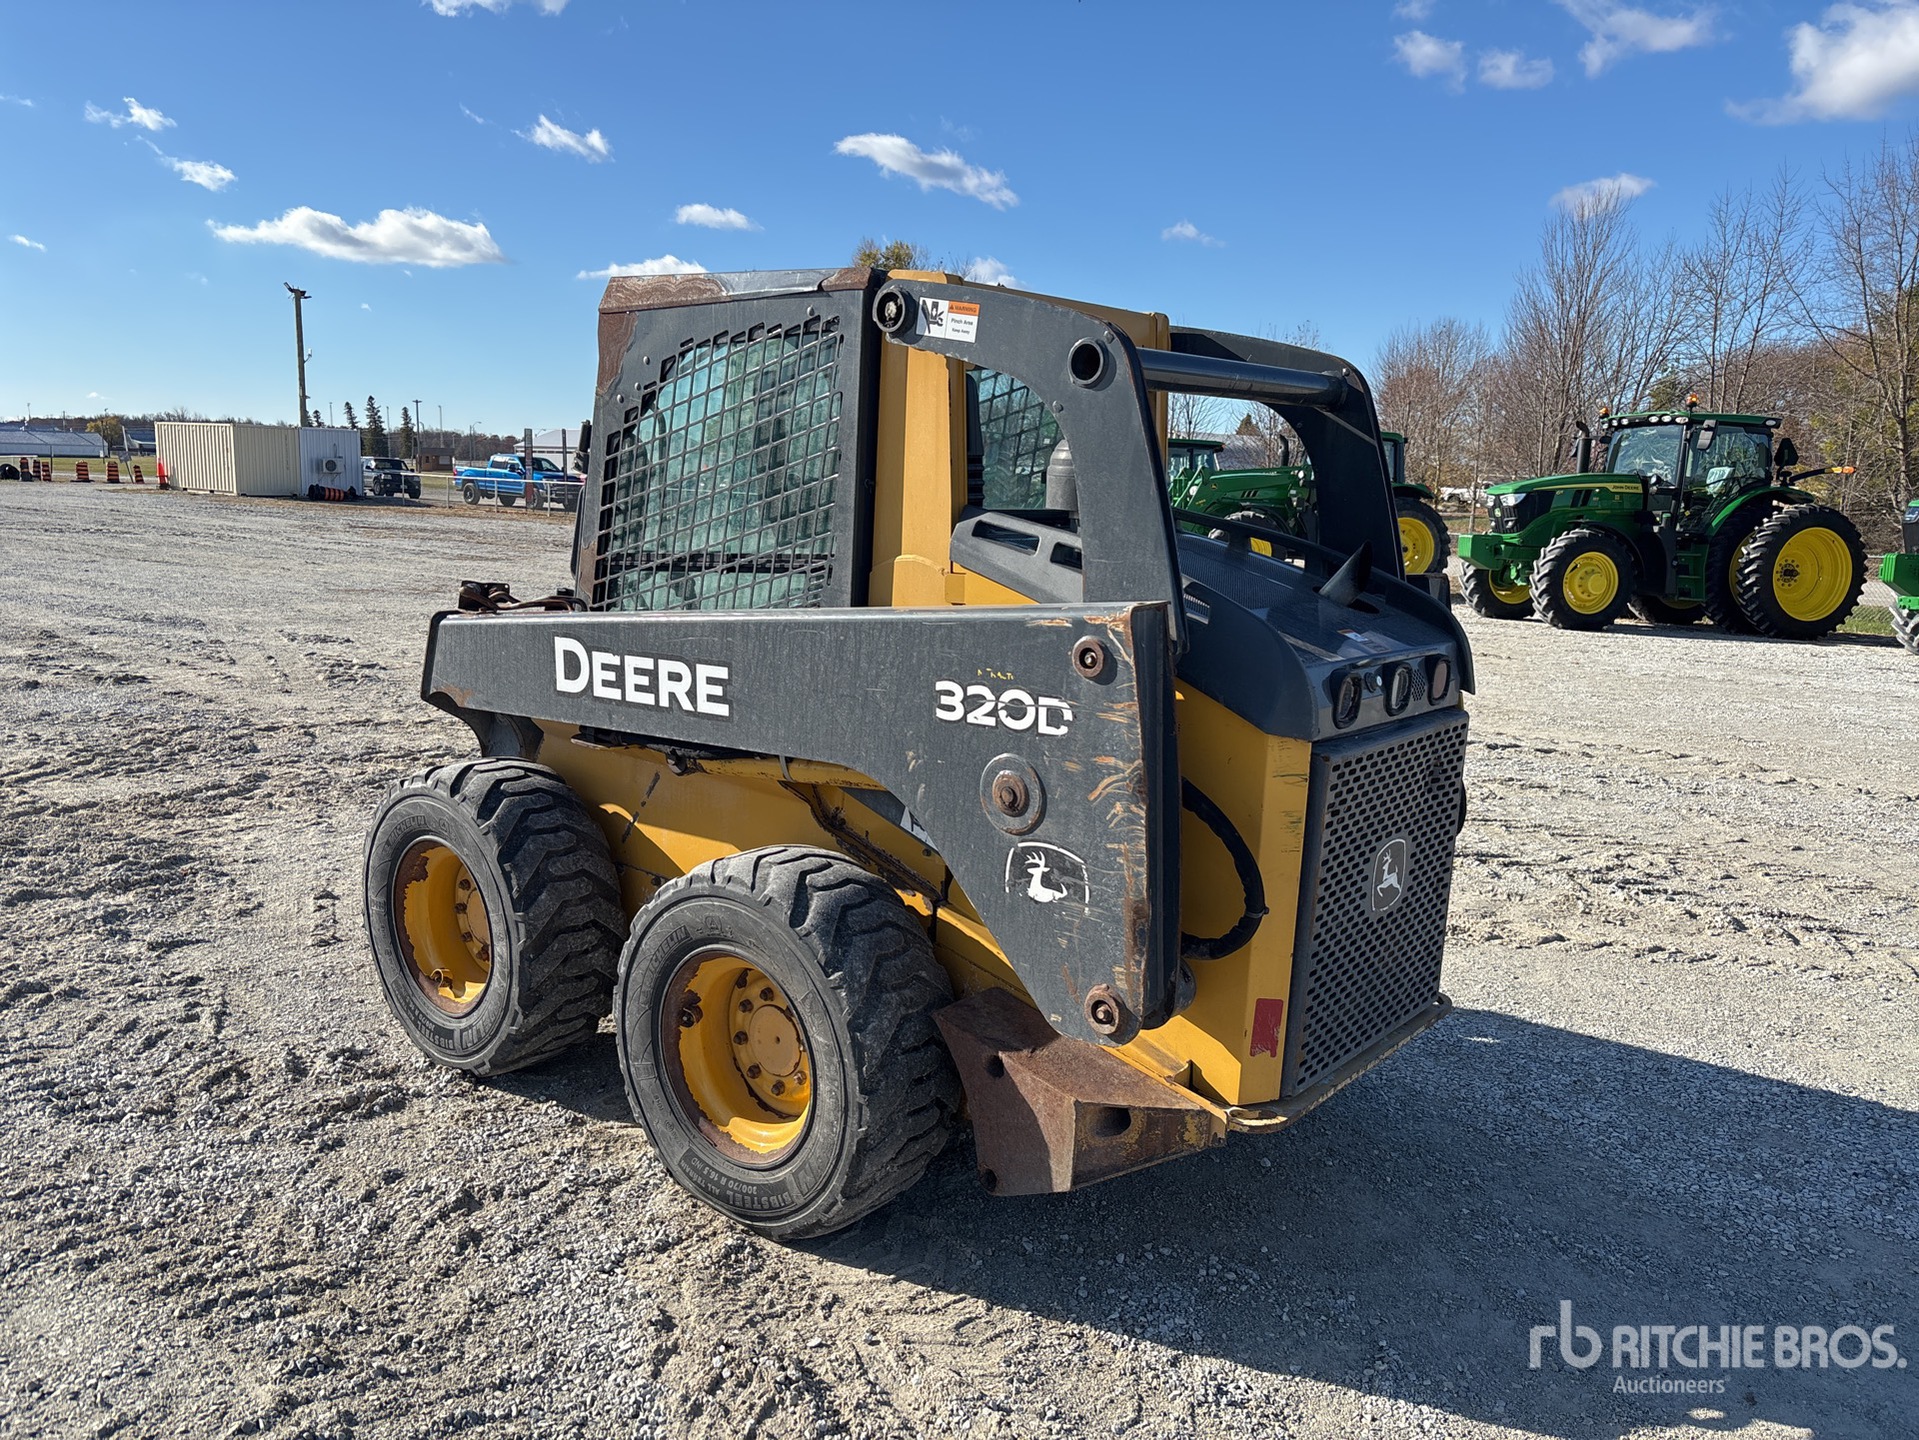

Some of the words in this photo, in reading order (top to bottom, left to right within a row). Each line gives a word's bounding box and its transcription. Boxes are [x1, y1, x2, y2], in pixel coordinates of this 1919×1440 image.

[935, 680, 1074, 736] 320D
[388, 815, 425, 846] MICHELIN
[679, 1159, 706, 1187] TERRAIN
[703, 1167, 718, 1181] 16.5
[720, 1176, 726, 1186] R
[708, 1184, 721, 1196] ALL
[727, 1180, 757, 1194] 300/70
[727, 1190, 793, 1210] BIBSTEEL
